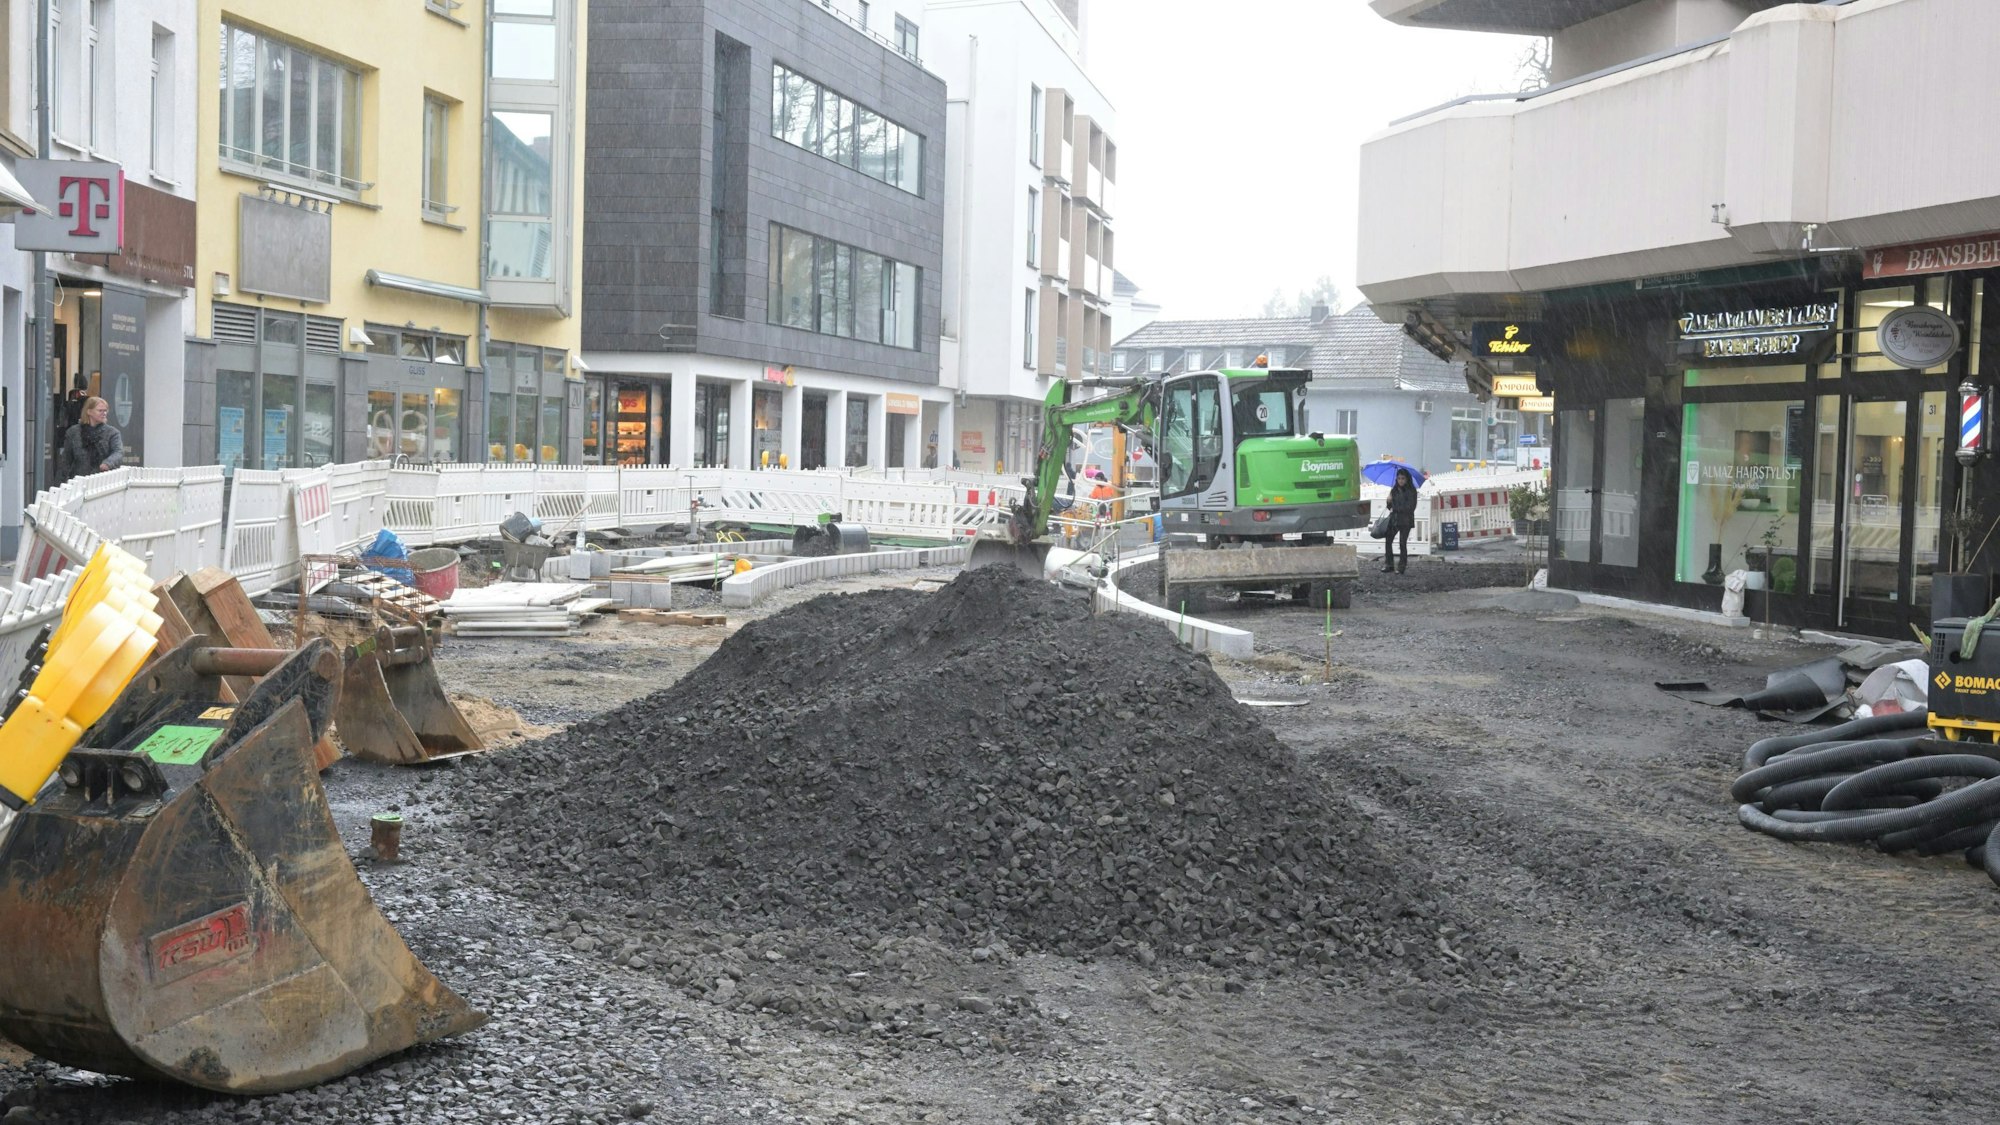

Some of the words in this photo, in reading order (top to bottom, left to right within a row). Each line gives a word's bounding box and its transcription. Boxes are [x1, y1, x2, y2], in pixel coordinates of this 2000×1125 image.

[59, 176, 110, 237] T
[1489, 341, 1531, 353] Tchibo
[1495, 381, 1537, 391] SYMPOSIO
[571, 387, 582, 407] 20
[1260, 407, 1267, 418] 20
[1929, 405, 1936, 415] 31
[1301, 460, 1343, 473] Boymann
[1703, 466, 1733, 479] ALMAZ
[1736, 466, 1798, 480] HAIRSTYLIST
